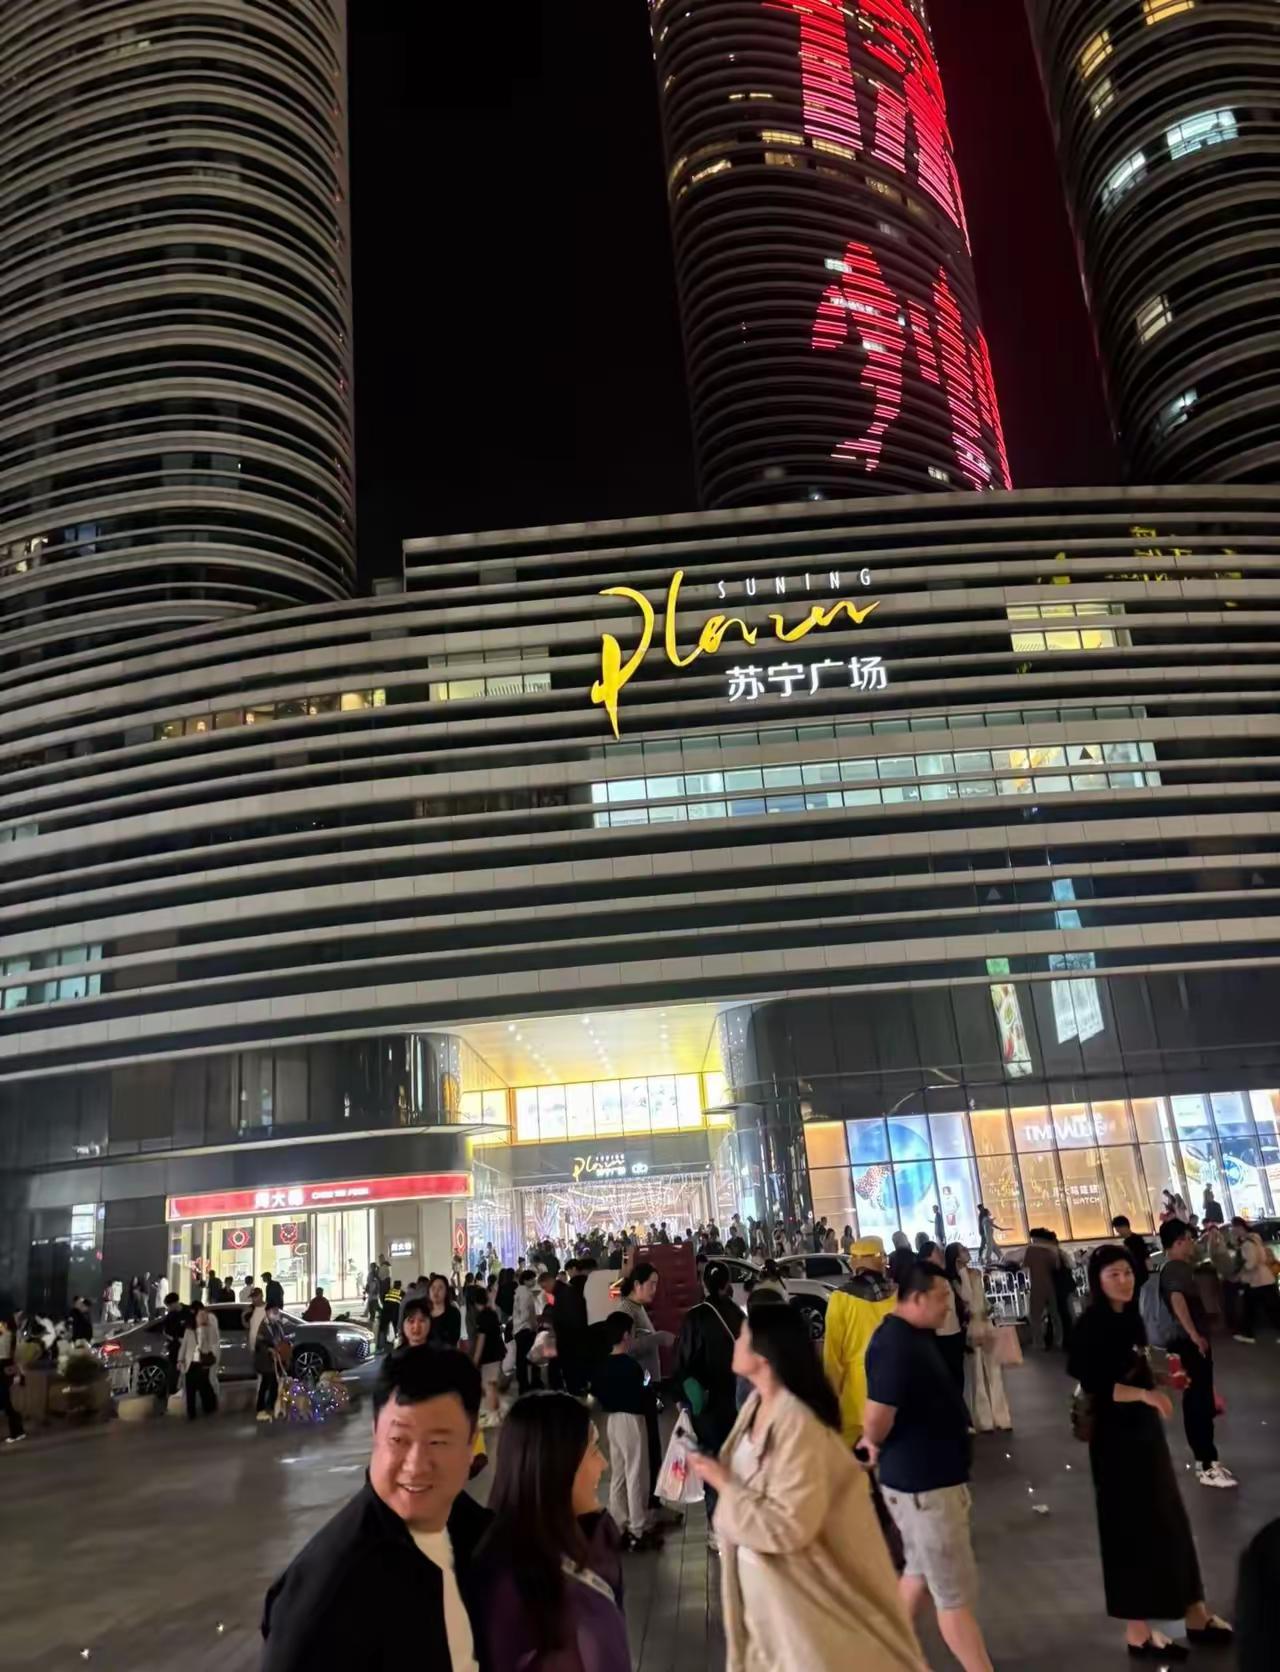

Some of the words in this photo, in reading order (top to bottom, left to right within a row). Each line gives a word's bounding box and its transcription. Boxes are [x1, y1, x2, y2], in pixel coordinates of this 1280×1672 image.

[715, 568, 873, 600] SUNING
[725, 656, 889, 702] 苏宁广场
